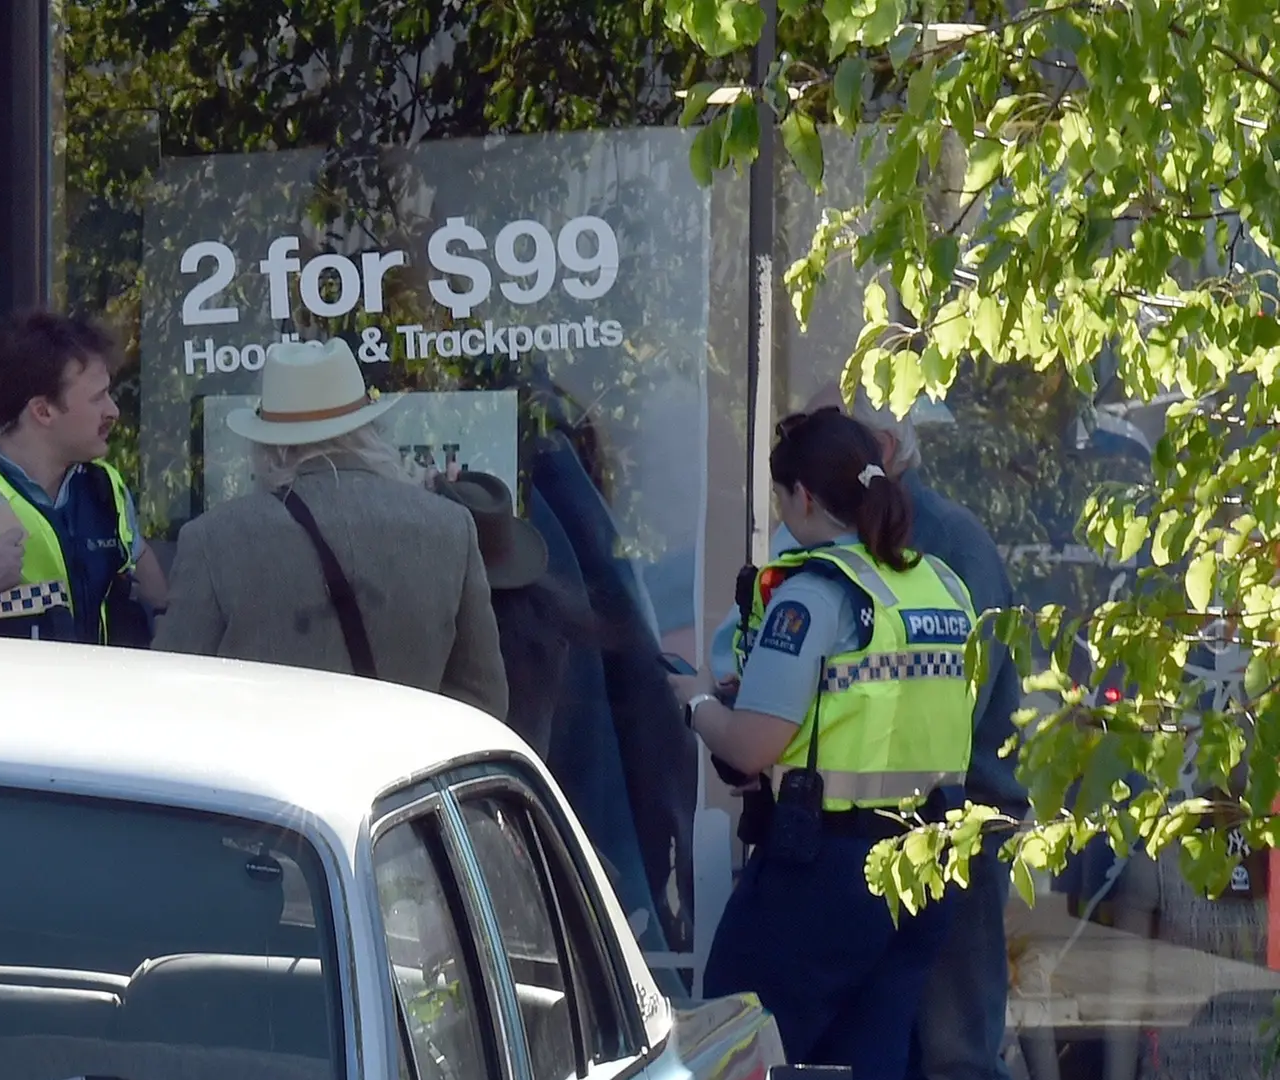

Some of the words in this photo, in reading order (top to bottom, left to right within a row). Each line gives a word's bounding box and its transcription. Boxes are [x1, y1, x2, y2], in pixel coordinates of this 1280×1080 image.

[180, 241, 239, 325] 2
[260, 236, 404, 319] for
[427, 215, 619, 319] $99
[358, 327, 390, 363] &
[397, 315, 624, 361] Trackpants
[909, 615, 968, 637] POLICE
